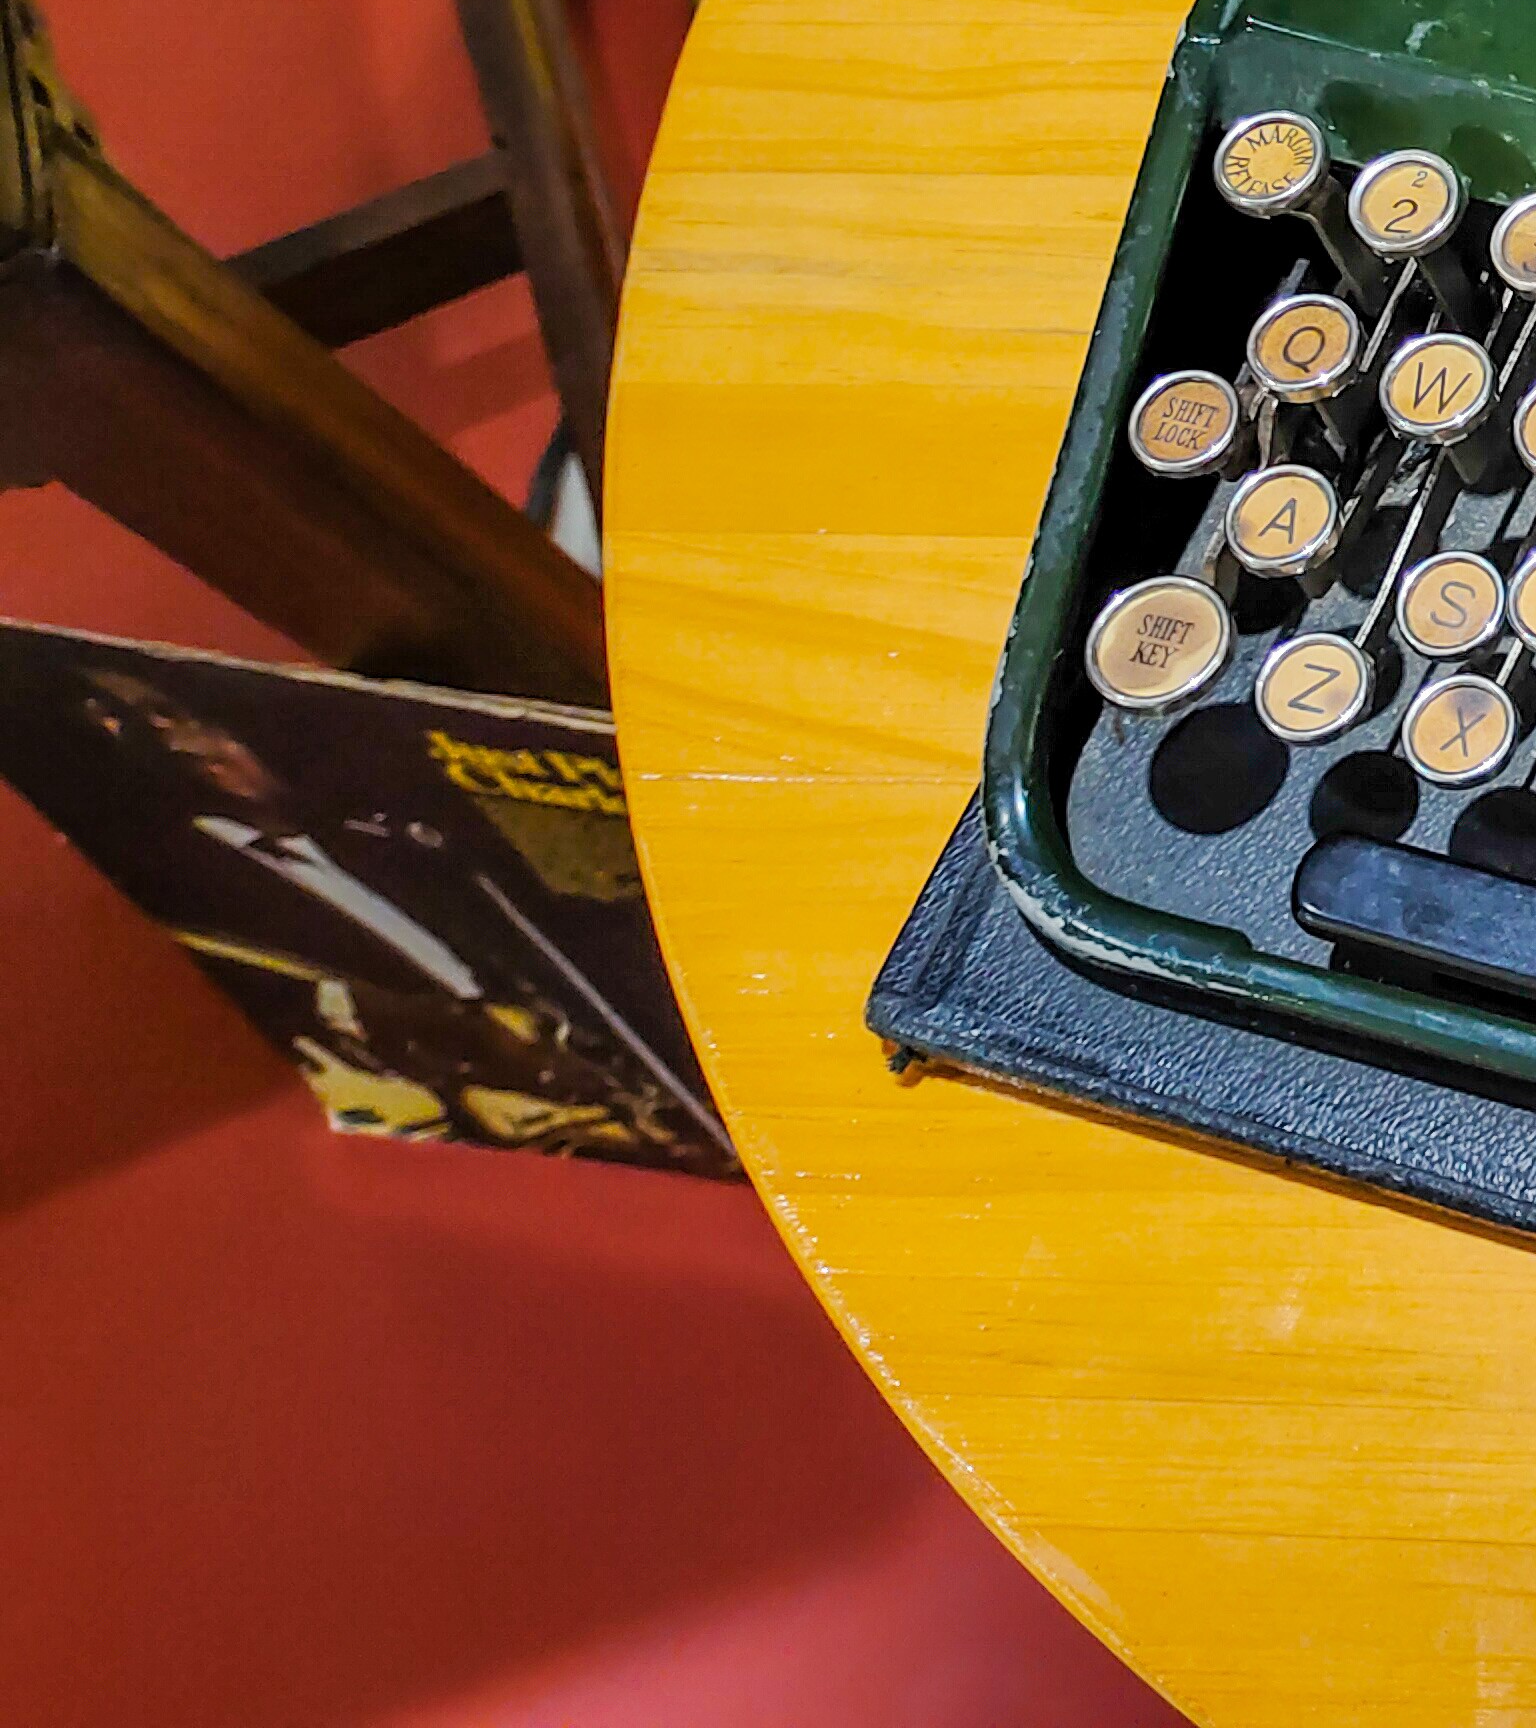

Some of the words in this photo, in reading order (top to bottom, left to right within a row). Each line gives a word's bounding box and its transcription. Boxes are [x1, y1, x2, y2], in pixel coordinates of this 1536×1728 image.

[1245, 124, 1313, 166] MARGIN
[1226, 155, 1295, 194] RELEASE
[1412, 170, 1429, 188] 2
[1384, 198, 1420, 234] 2
[1283, 325, 1326, 373] Q
[1415, 361, 1473, 414] W
[1163, 396, 1219, 429] SHIFT
[1154, 421, 1205, 451] LOCK
[1257, 497, 1299, 544] A
[1430, 581, 1477, 629] S
[1135, 612, 1195, 645] SHIFT
[1128, 640, 1179, 670] KEY
[1287, 663, 1342, 715] Z
[1440, 707, 1486, 758] X
